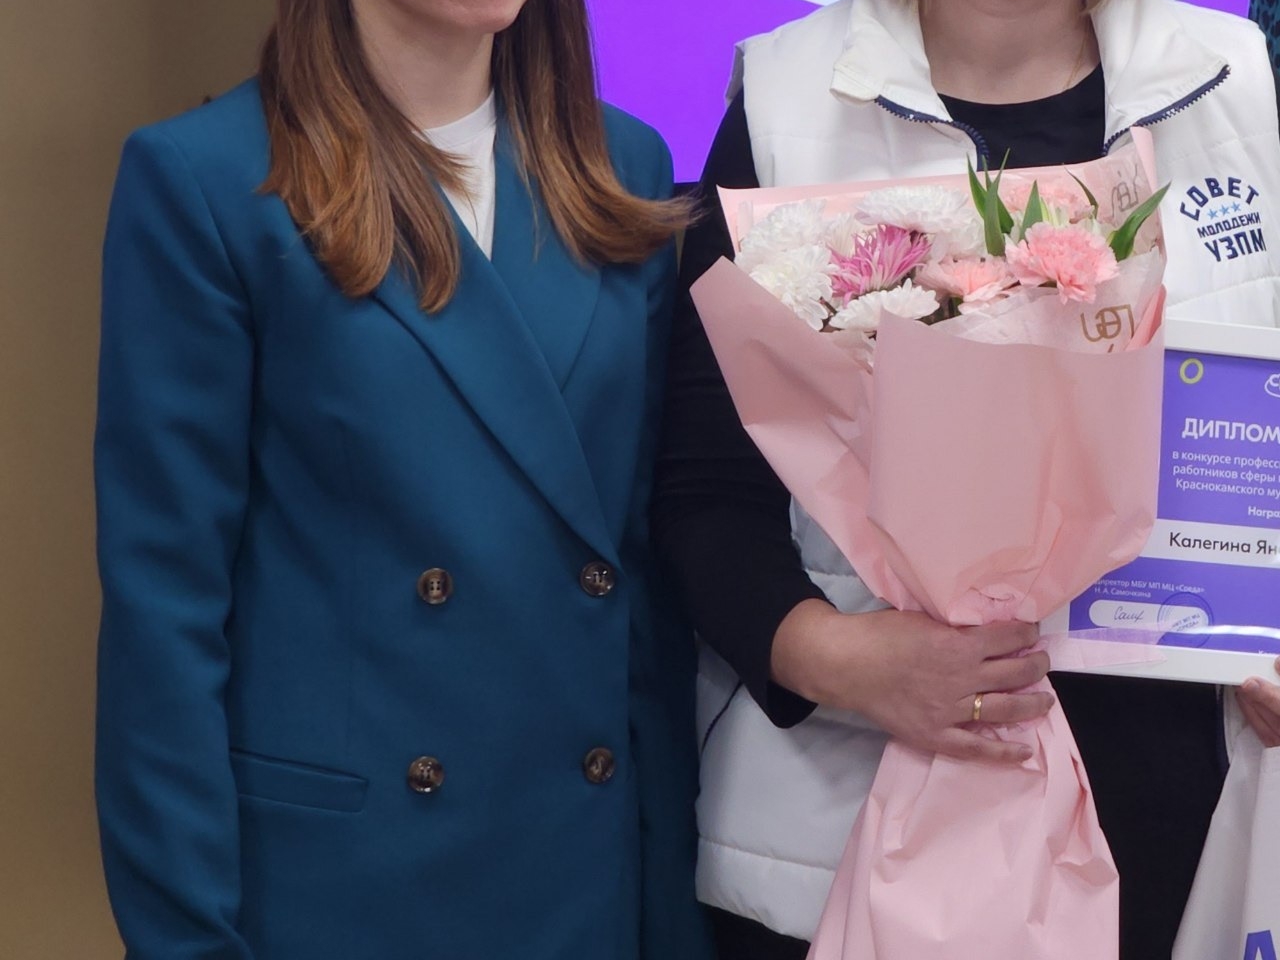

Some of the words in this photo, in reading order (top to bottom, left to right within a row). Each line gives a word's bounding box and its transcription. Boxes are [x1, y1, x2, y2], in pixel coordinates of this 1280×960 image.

[1180, 177, 1259, 221] СОВЕТ
[1197, 212, 1261, 238] МОЛОДЕЖИ
[1172, 451, 1179, 460] в
[1181, 452, 1231, 466] конкурсе
[1173, 465, 1238, 480] работников
[1240, 470, 1276, 483] сферы
[1175, 479, 1265, 497] Краснокамского
[1169, 532, 1251, 554] Калегина
